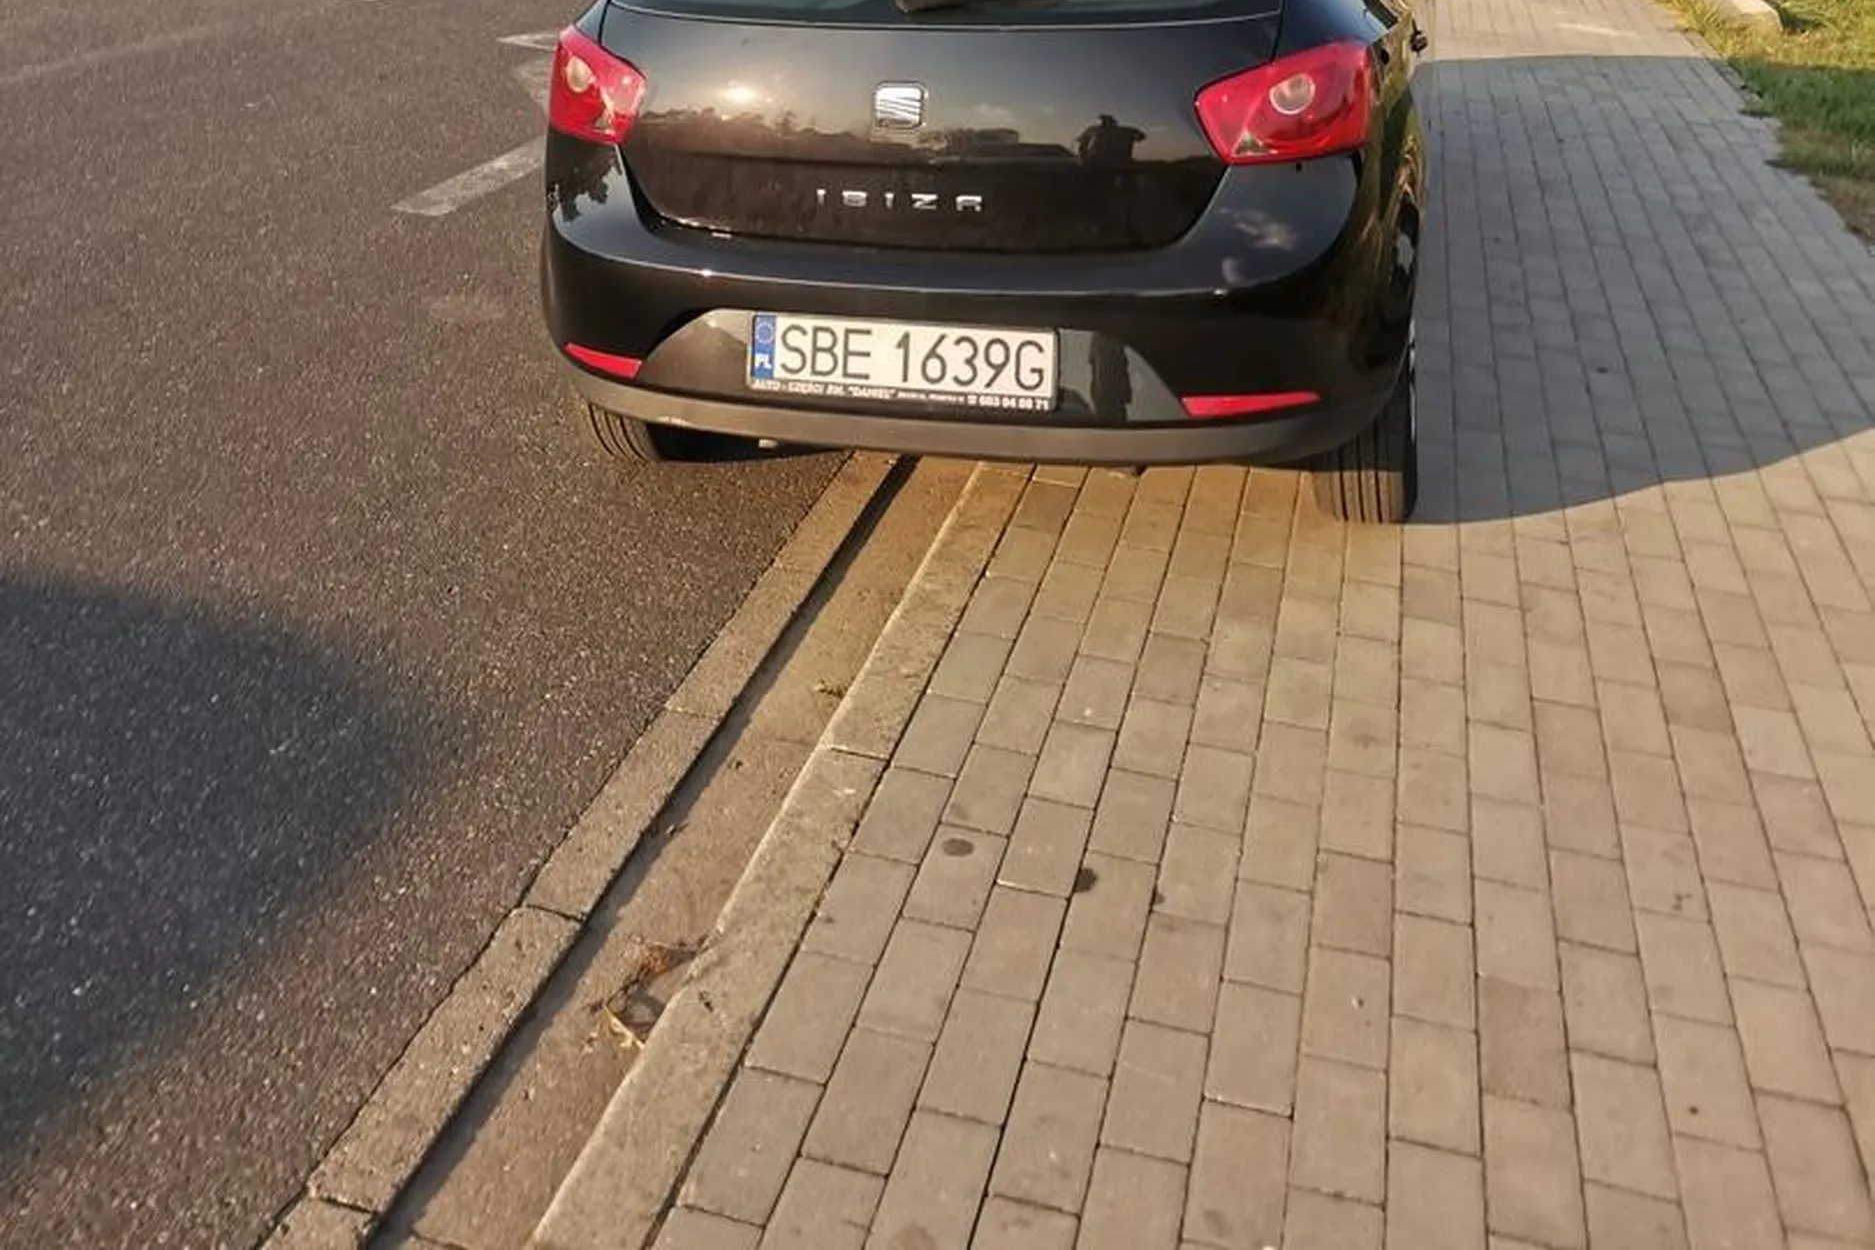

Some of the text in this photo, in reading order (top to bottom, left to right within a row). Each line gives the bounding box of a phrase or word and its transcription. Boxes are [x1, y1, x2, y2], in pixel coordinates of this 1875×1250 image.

[816, 188, 983, 213] IBIZA
[754, 353, 772, 369] PL
[780, 323, 1045, 391] SBE 1639G
